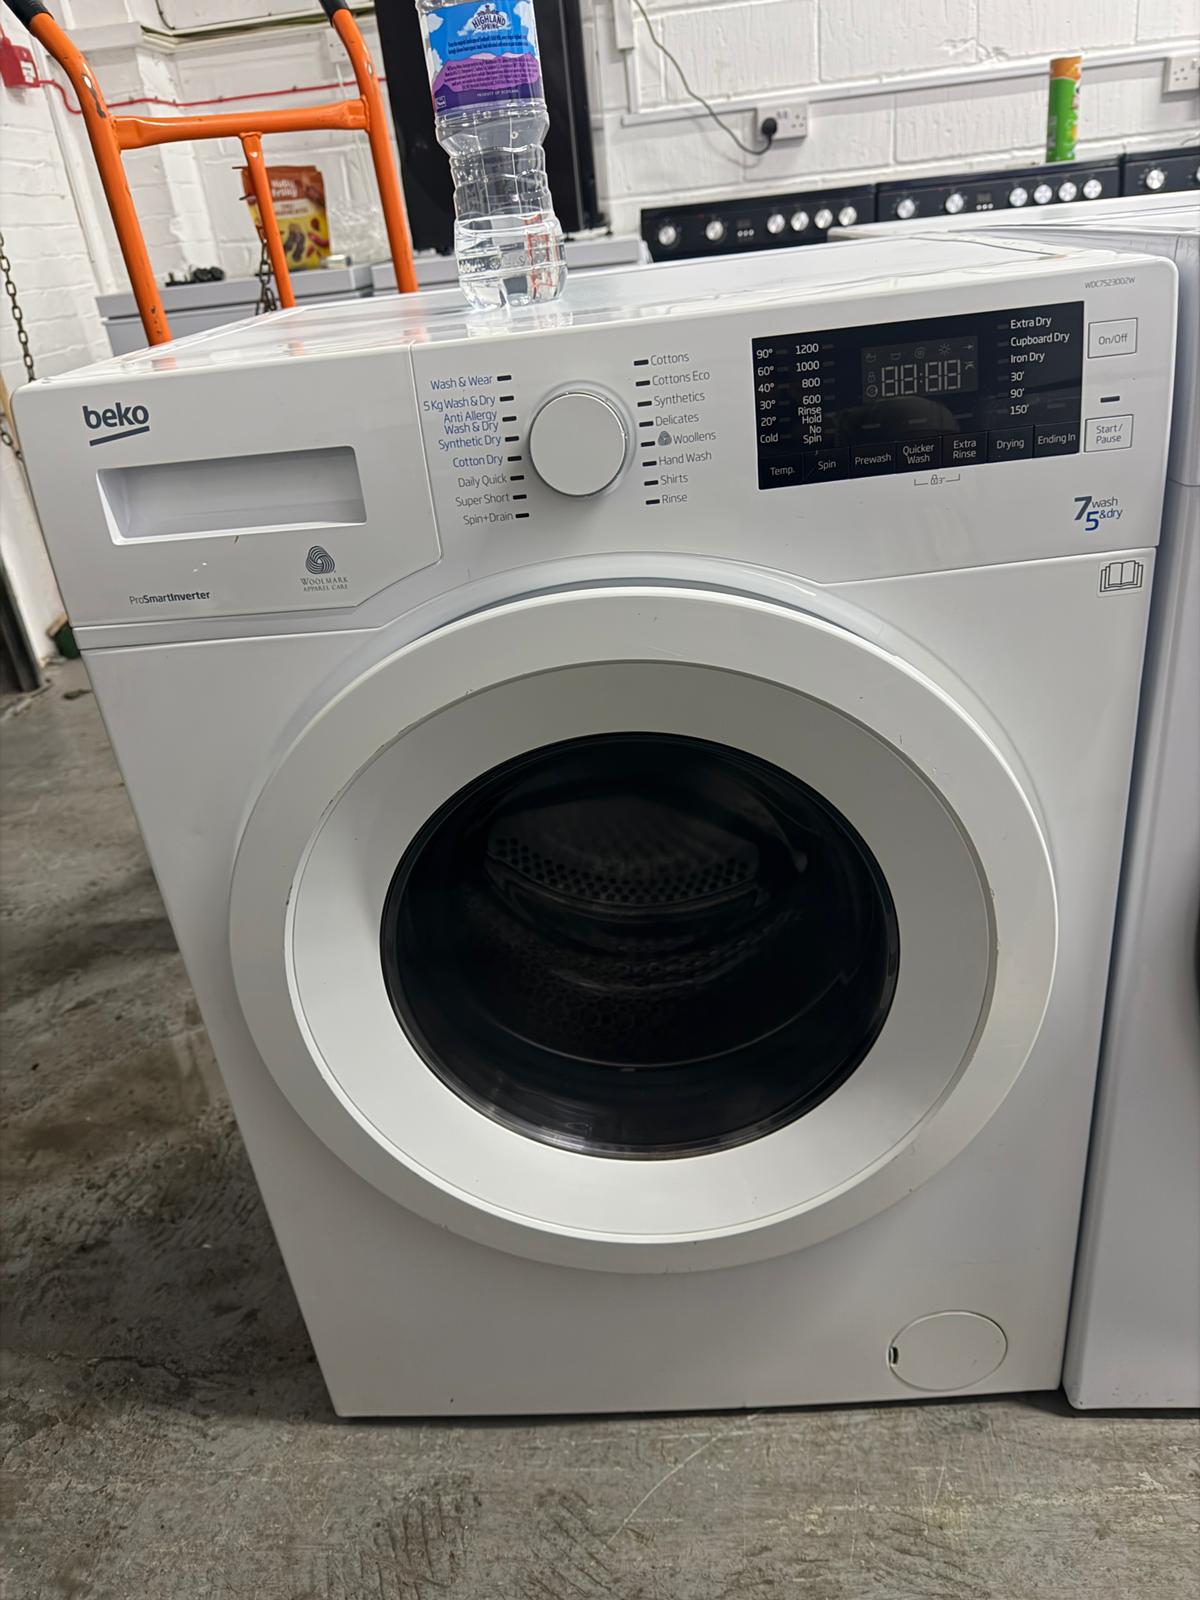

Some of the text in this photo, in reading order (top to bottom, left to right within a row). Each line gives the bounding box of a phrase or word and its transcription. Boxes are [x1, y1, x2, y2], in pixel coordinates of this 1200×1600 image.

[472, 14, 506, 29] HIGHLAND
[481, 23, 500, 31] SPRING
[1010, 316, 1052, 329] Extra Dry
[1010, 332, 1070, 348] Cupboard Dry
[1098, 332, 1128, 346] On/Off
[795, 343, 819, 355] 1200
[650, 353, 690, 366] Cottons
[1010, 352, 1046, 364] Iron Dry
[796, 360, 820, 372] 1000
[430, 375, 493, 390] Wash & Wear
[652, 370, 710, 386] Cottons Eco
[801, 377, 821, 388] 800
[423, 394, 496, 412] 5 Kg Wash & Dry
[654, 392, 706, 408] Synthetics
[802, 394, 821, 405] 600
[82, 402, 150, 429] beko
[444, 410, 498, 423] Anti Allergy
[797, 406, 822, 416] Rinse
[655, 413, 700, 427] Delicates
[802, 415, 822, 425] Hold
[444, 420, 499, 435] Wash & Dry
[809, 425, 822, 434] No
[438, 435, 501, 452] Synthetic Dry
[673, 431, 717, 444] Woollens
[760, 433, 779, 443] Cold
[802, 434, 822, 445] Spin
[1037, 433, 1076, 446] Ending In
[1095, 434, 1122, 444] Pause
[902, 442, 934, 455] Quicker
[953, 439, 977, 450] Extra
[996, 439, 1025, 451] Drying
[659, 451, 712, 466] Hand Wash
[855, 453, 892, 465] Prewash
[906, 454, 931, 465] Wash
[952, 449, 977, 459] Rinse
[452, 454, 503, 468] Cotton Dry
[817, 460, 837, 471] Spin
[769, 466, 796, 477] Temp.
[458, 473, 508, 488] Daily Quick
[660, 474, 689, 485] Shirts
[455, 493, 510, 507] Super Short
[662, 494, 688, 504] Rinse
[1074, 495, 1118, 520] 7 wash
[463, 512, 514, 525] Spin+Drain
[1085, 511, 1100, 531] 5
[300, 576, 349, 586] WOOLMARK
[129, 590, 210, 605] ProSmartInverter
